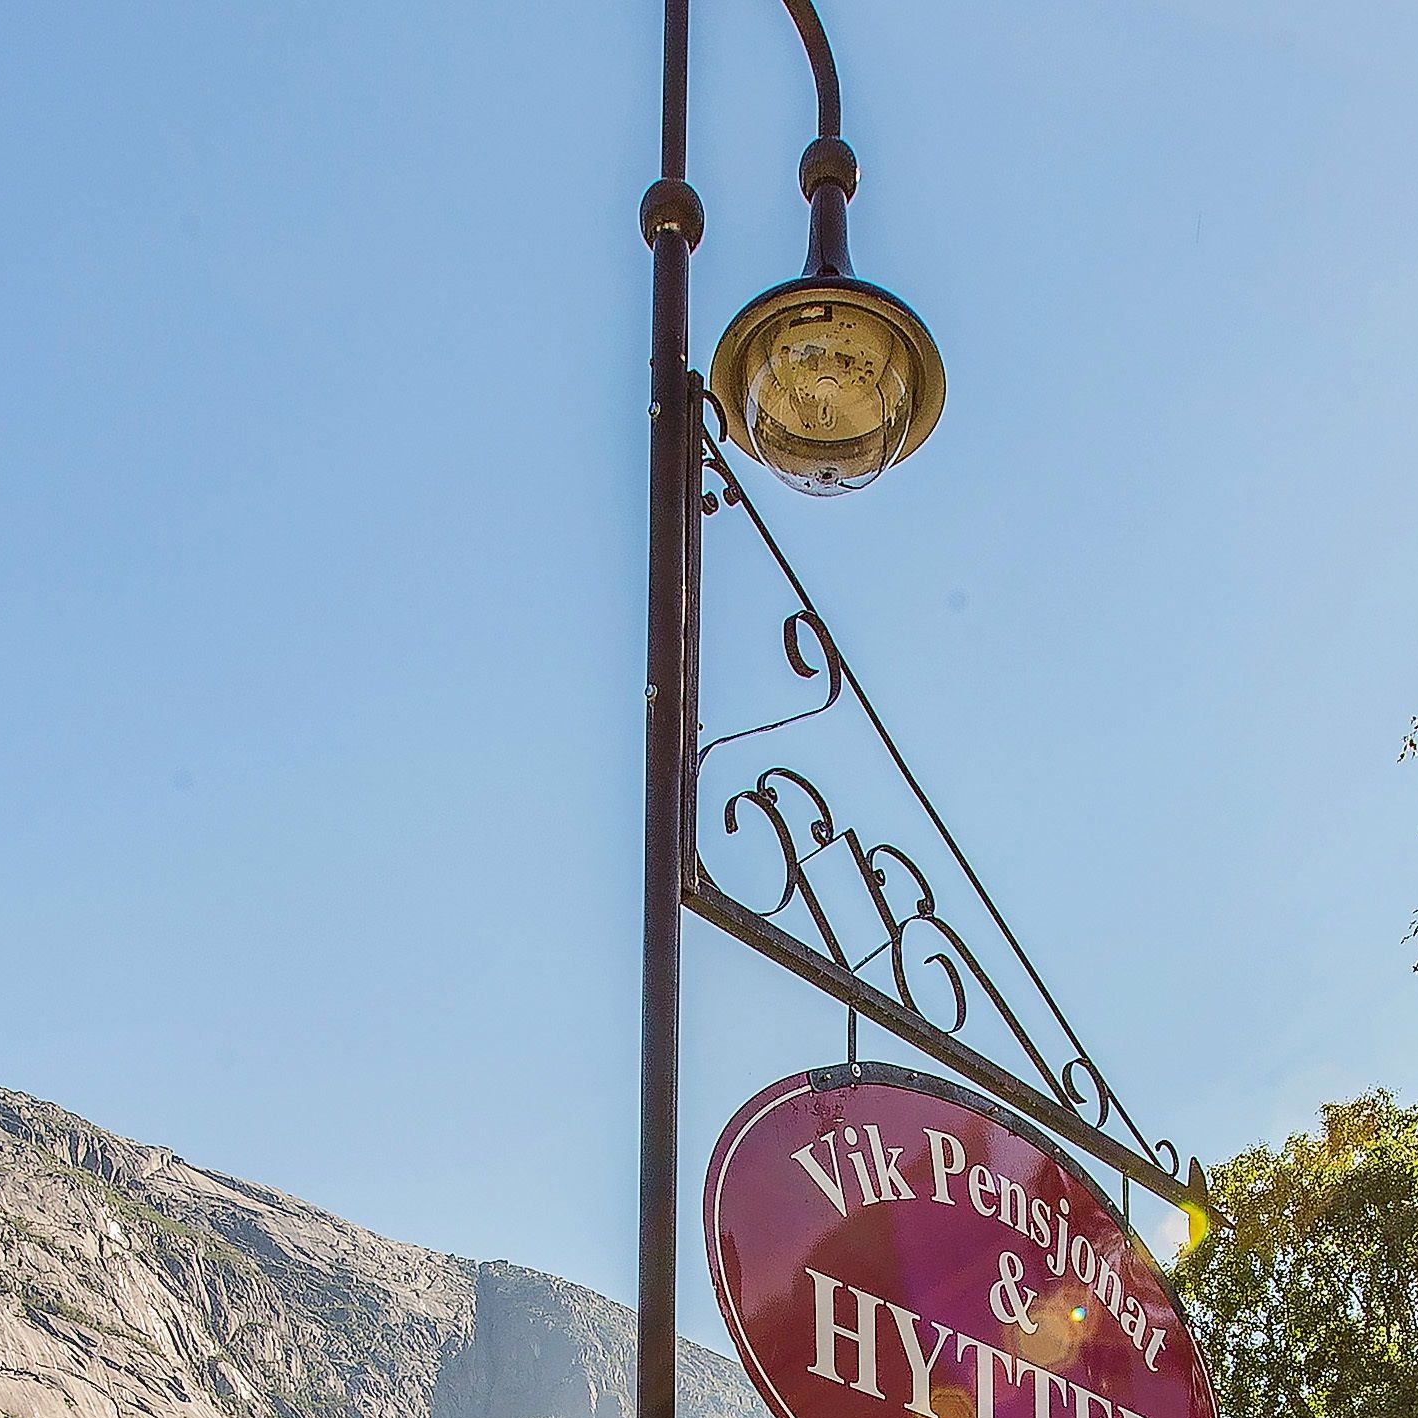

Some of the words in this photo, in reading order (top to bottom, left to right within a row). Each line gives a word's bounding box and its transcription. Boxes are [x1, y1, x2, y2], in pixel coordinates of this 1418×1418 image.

[791, 1125, 916, 1218] Vik
[923, 1127, 1168, 1372] Pensjonat
[989, 1250, 1039, 1335] &
